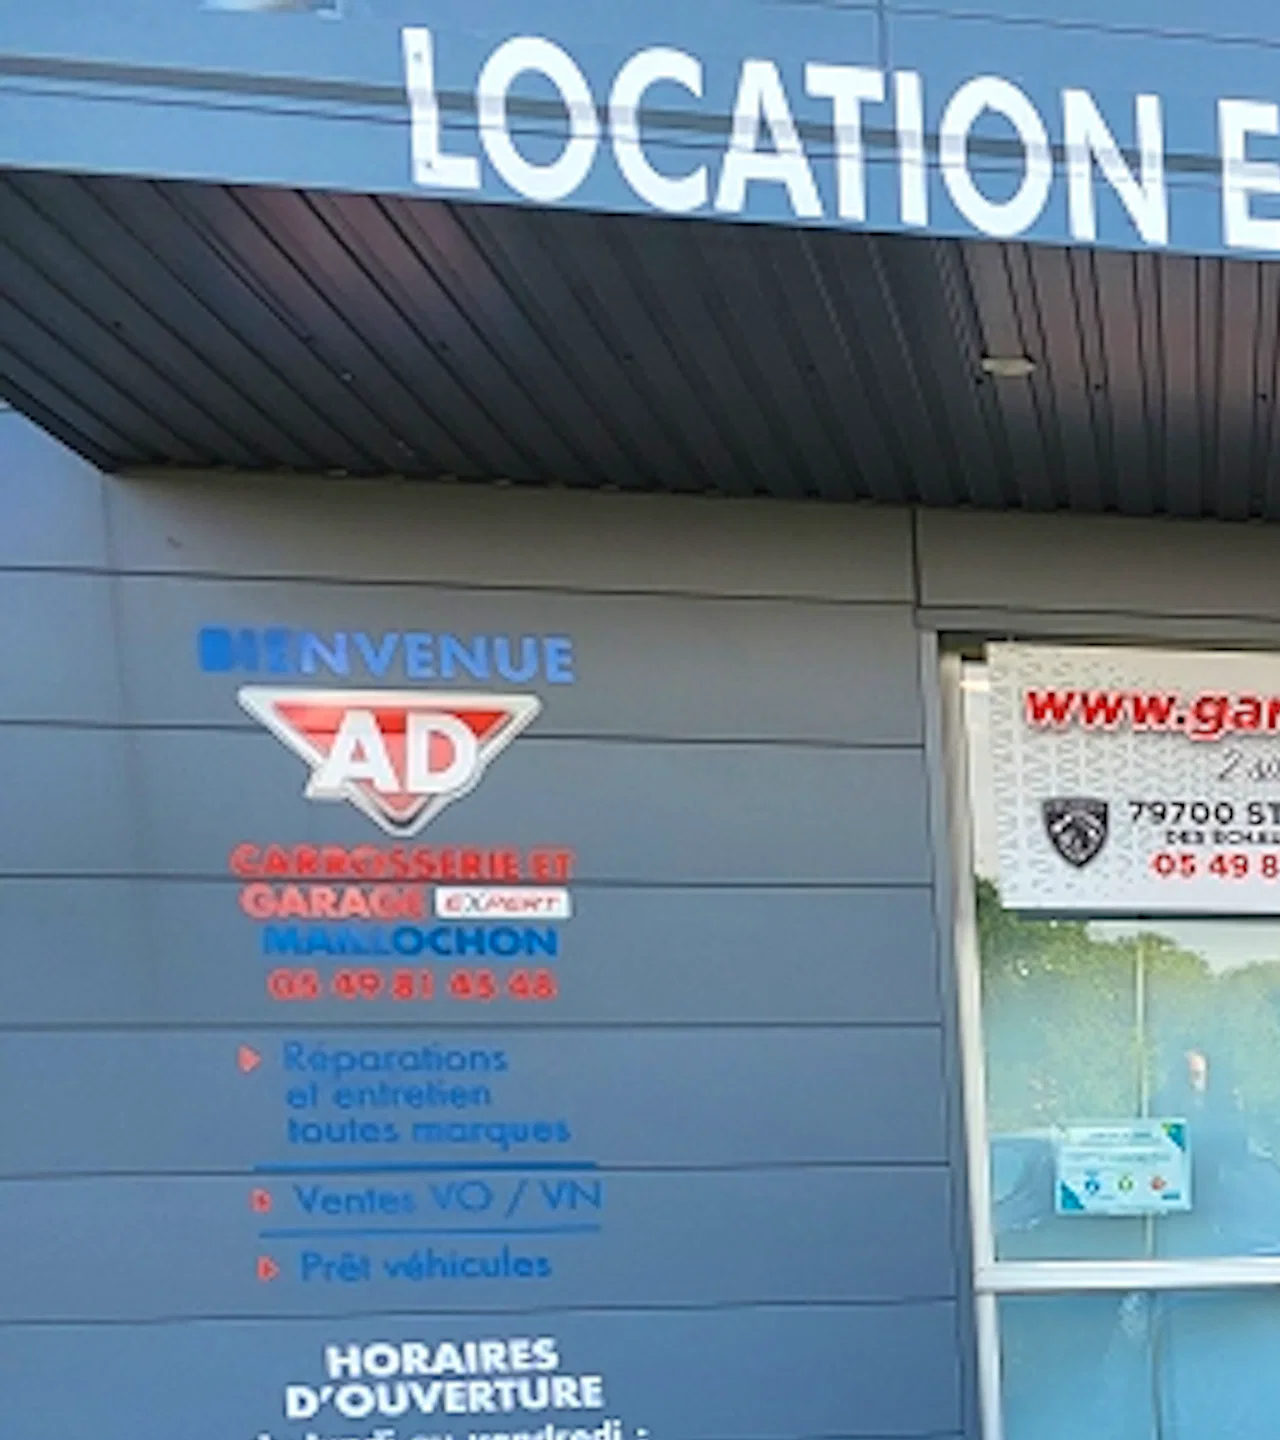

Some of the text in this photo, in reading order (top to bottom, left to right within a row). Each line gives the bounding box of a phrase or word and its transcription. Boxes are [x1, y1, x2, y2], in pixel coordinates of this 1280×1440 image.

[399, 27, 1168, 246] LOCATION
[306, 709, 480, 798] AD
[1129, 801, 1235, 826] 79700
[229, 843, 576, 882] CARROSSERIE ET
[1153, 852, 1197, 879] 05
[1208, 853, 1250, 879] 49
[239, 882, 426, 920] GARAGE
[262, 925, 559, 956] MAILLOCHON
[267, 968, 320, 1000] 05
[333, 968, 383, 1000] 49
[392, 968, 434, 1000] 81
[282, 1039, 510, 1080] Réparations
[285, 1078, 492, 1110] et entretien
[286, 1115, 572, 1153] toutes marques
[291, 1182, 417, 1216] Ventes
[428, 1179, 492, 1213] VO
[539, 1179, 604, 1210] VN
[300, 1245, 553, 1283] Prêt véhicules
[324, 1336, 560, 1379] HORAIRES
[285, 1375, 606, 1420] D'OUVERTURE
